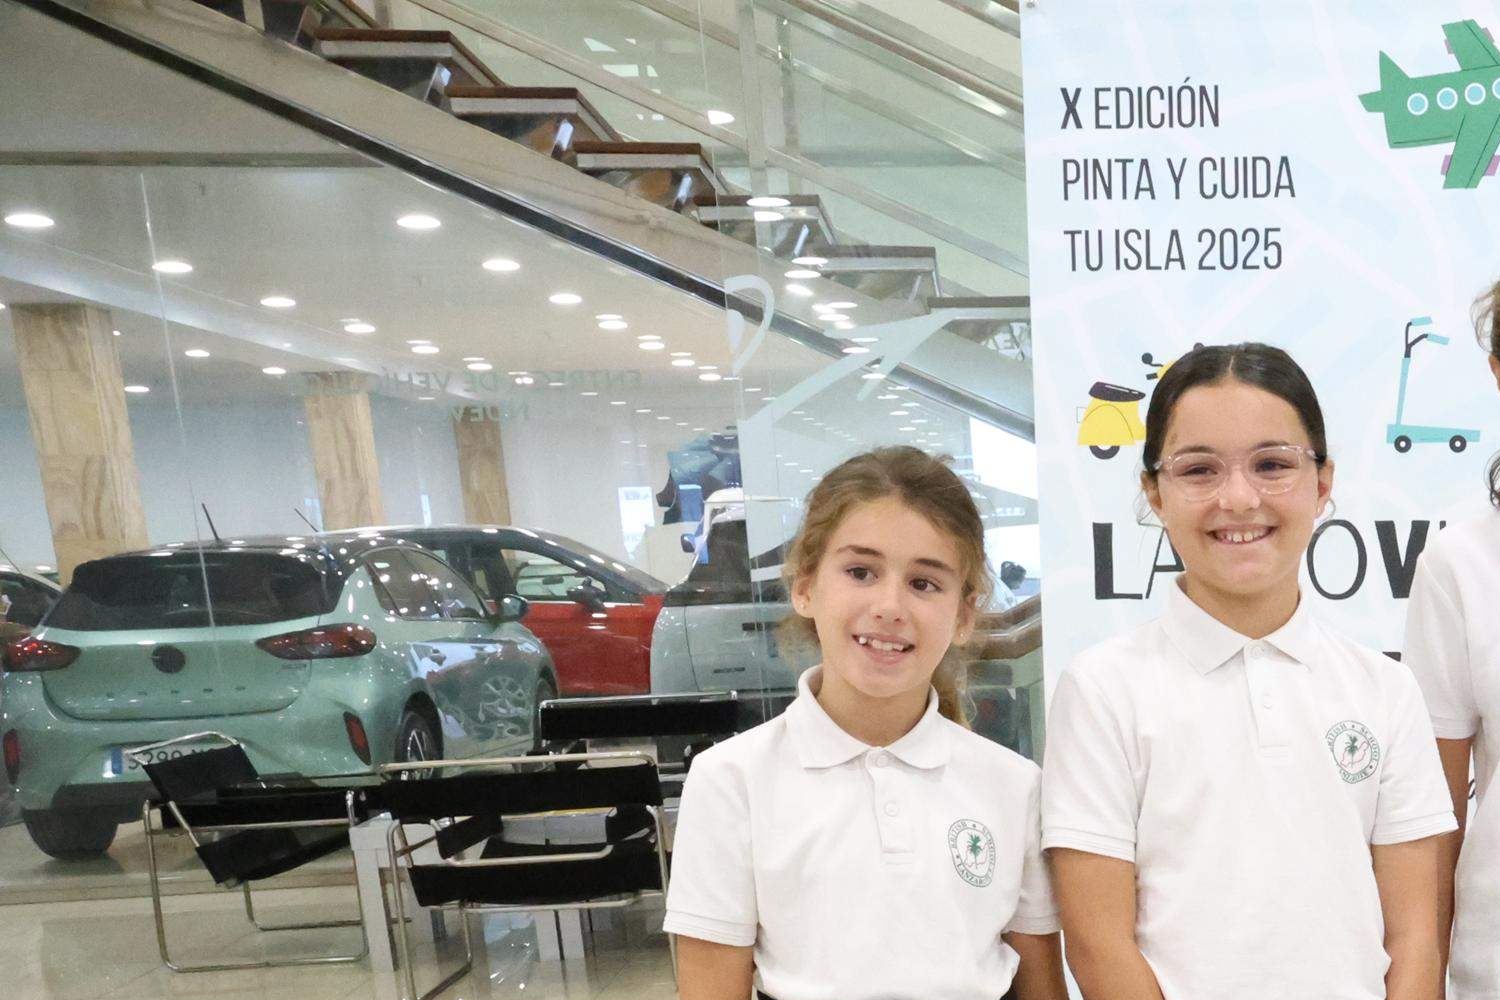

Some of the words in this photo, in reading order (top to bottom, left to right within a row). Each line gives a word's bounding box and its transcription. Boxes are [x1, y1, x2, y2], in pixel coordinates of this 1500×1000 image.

[1060, 87, 1083, 130] X
[1094, 77, 1219, 129] EDICIÓN
[1062, 158, 1156, 201] PINTA
[1166, 157, 1187, 200] Y
[1199, 156, 1296, 200] CUIDA
[1063, 229, 1104, 272] TU
[1115, 228, 1186, 271] ISLA
[1197, 227, 1282, 271] 2025
